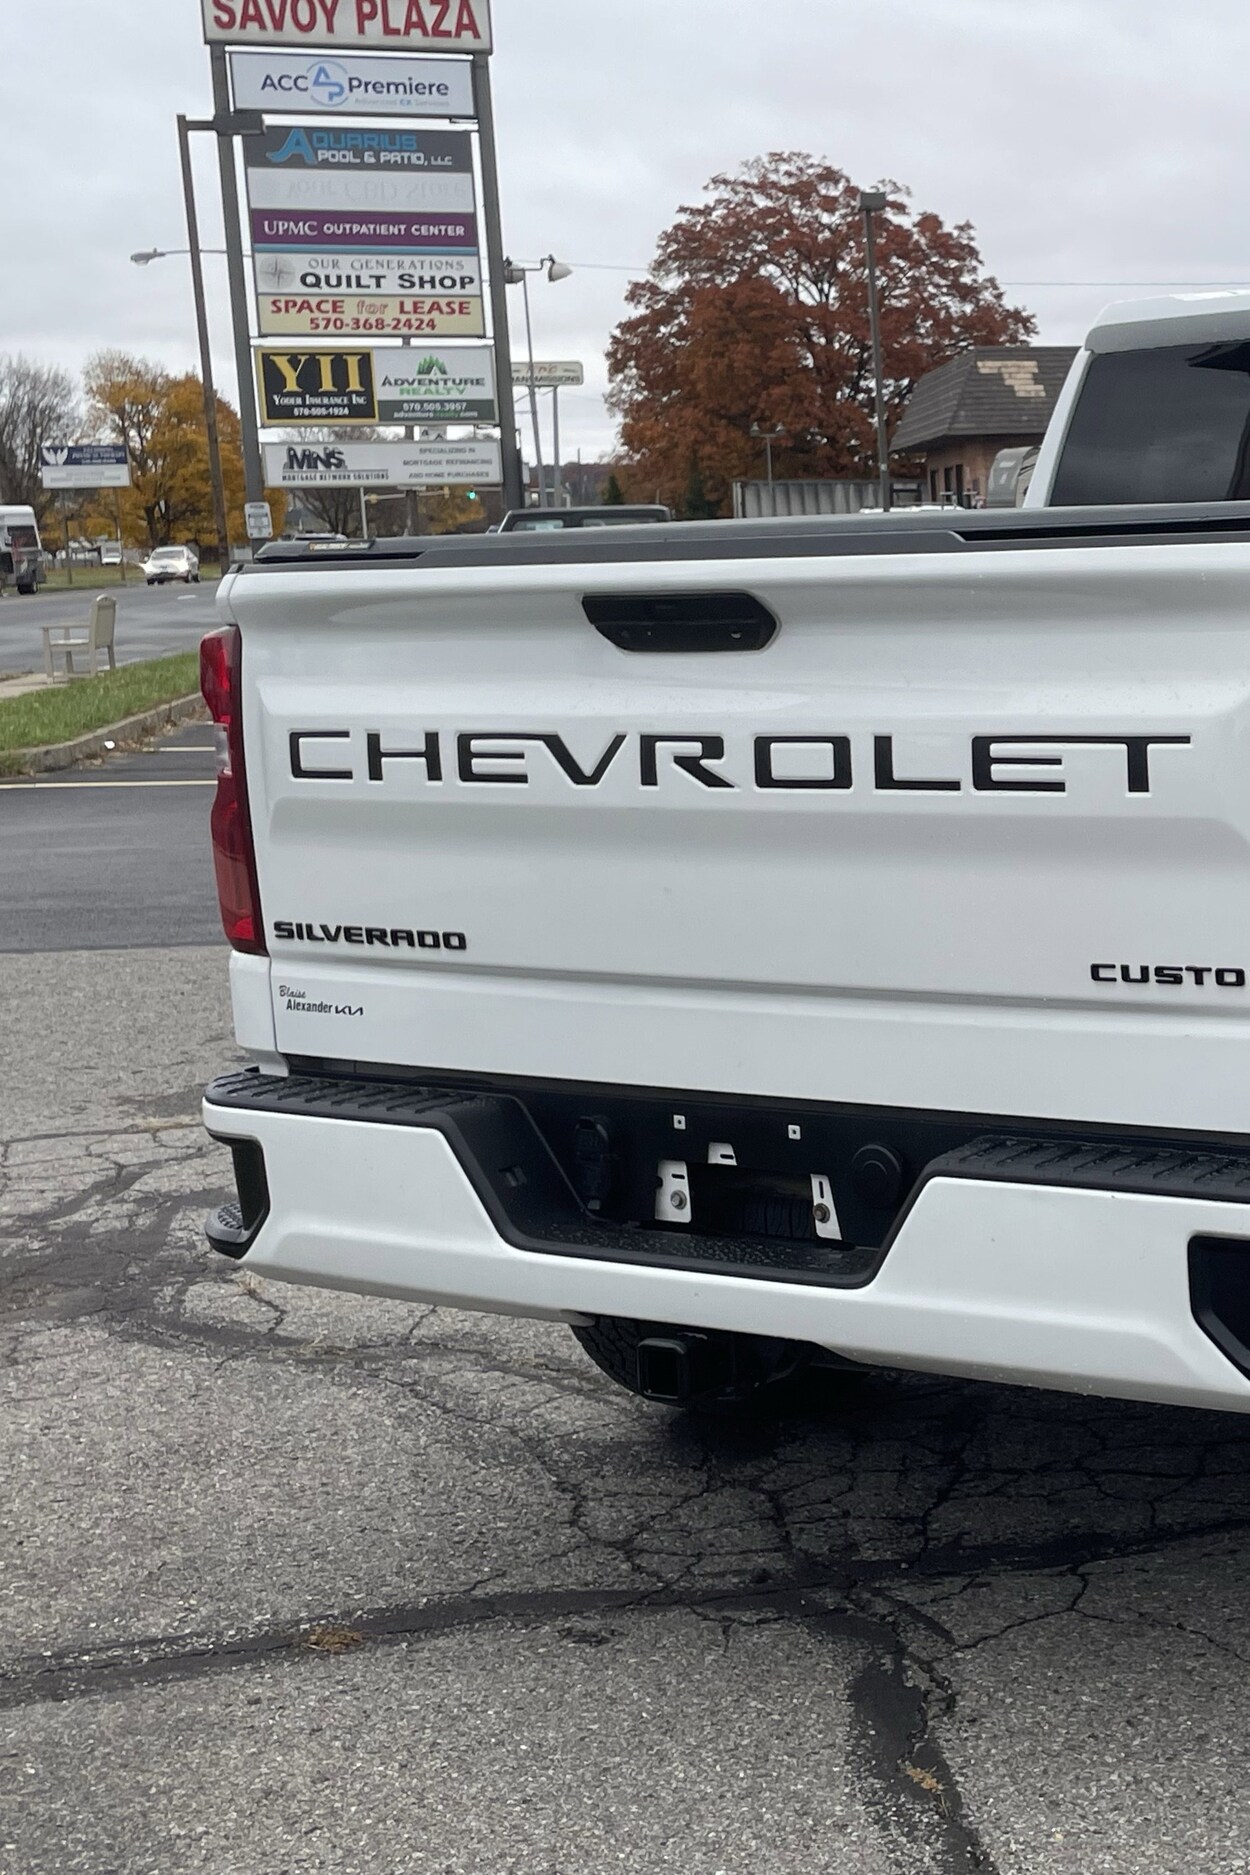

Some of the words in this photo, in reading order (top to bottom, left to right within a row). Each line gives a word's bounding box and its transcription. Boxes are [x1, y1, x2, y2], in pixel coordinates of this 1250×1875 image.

[212, 0, 340, 34] SAVOY
[355, 0, 482, 39] PLAZA
[261, 74, 309, 92] ACC
[348, 77, 450, 97] Premiere
[265, 127, 418, 165] AQUARIUS
[317, 149, 361, 164] POOL
[364, 150, 377, 164] &
[380, 151, 428, 166] PATIO,
[431, 155, 453, 166] LLC
[263, 219, 318, 236] UPMC
[323, 222, 407, 235] OUTPATIENT
[411, 223, 466, 237] CENTER
[307, 258, 341, 270] OUR
[350, 258, 465, 271] GENERATIONS
[299, 272, 387, 289] QUILT
[397, 272, 475, 290] SHOP
[270, 298, 345, 315] SPACE
[356, 299, 389, 315] for
[398, 299, 472, 315] LEASE
[309, 317, 438, 332] 570-368-2424
[269, 354, 366, 393] YII
[380, 375, 486, 387] ADVENTURE
[399, 386, 467, 396] REALTY
[288, 730, 1192, 795] CHEVROLET
[273, 919, 468, 952] SILVERADO
[278, 984, 307, 999] Blaise
[286, 998, 333, 1014] Alexander
